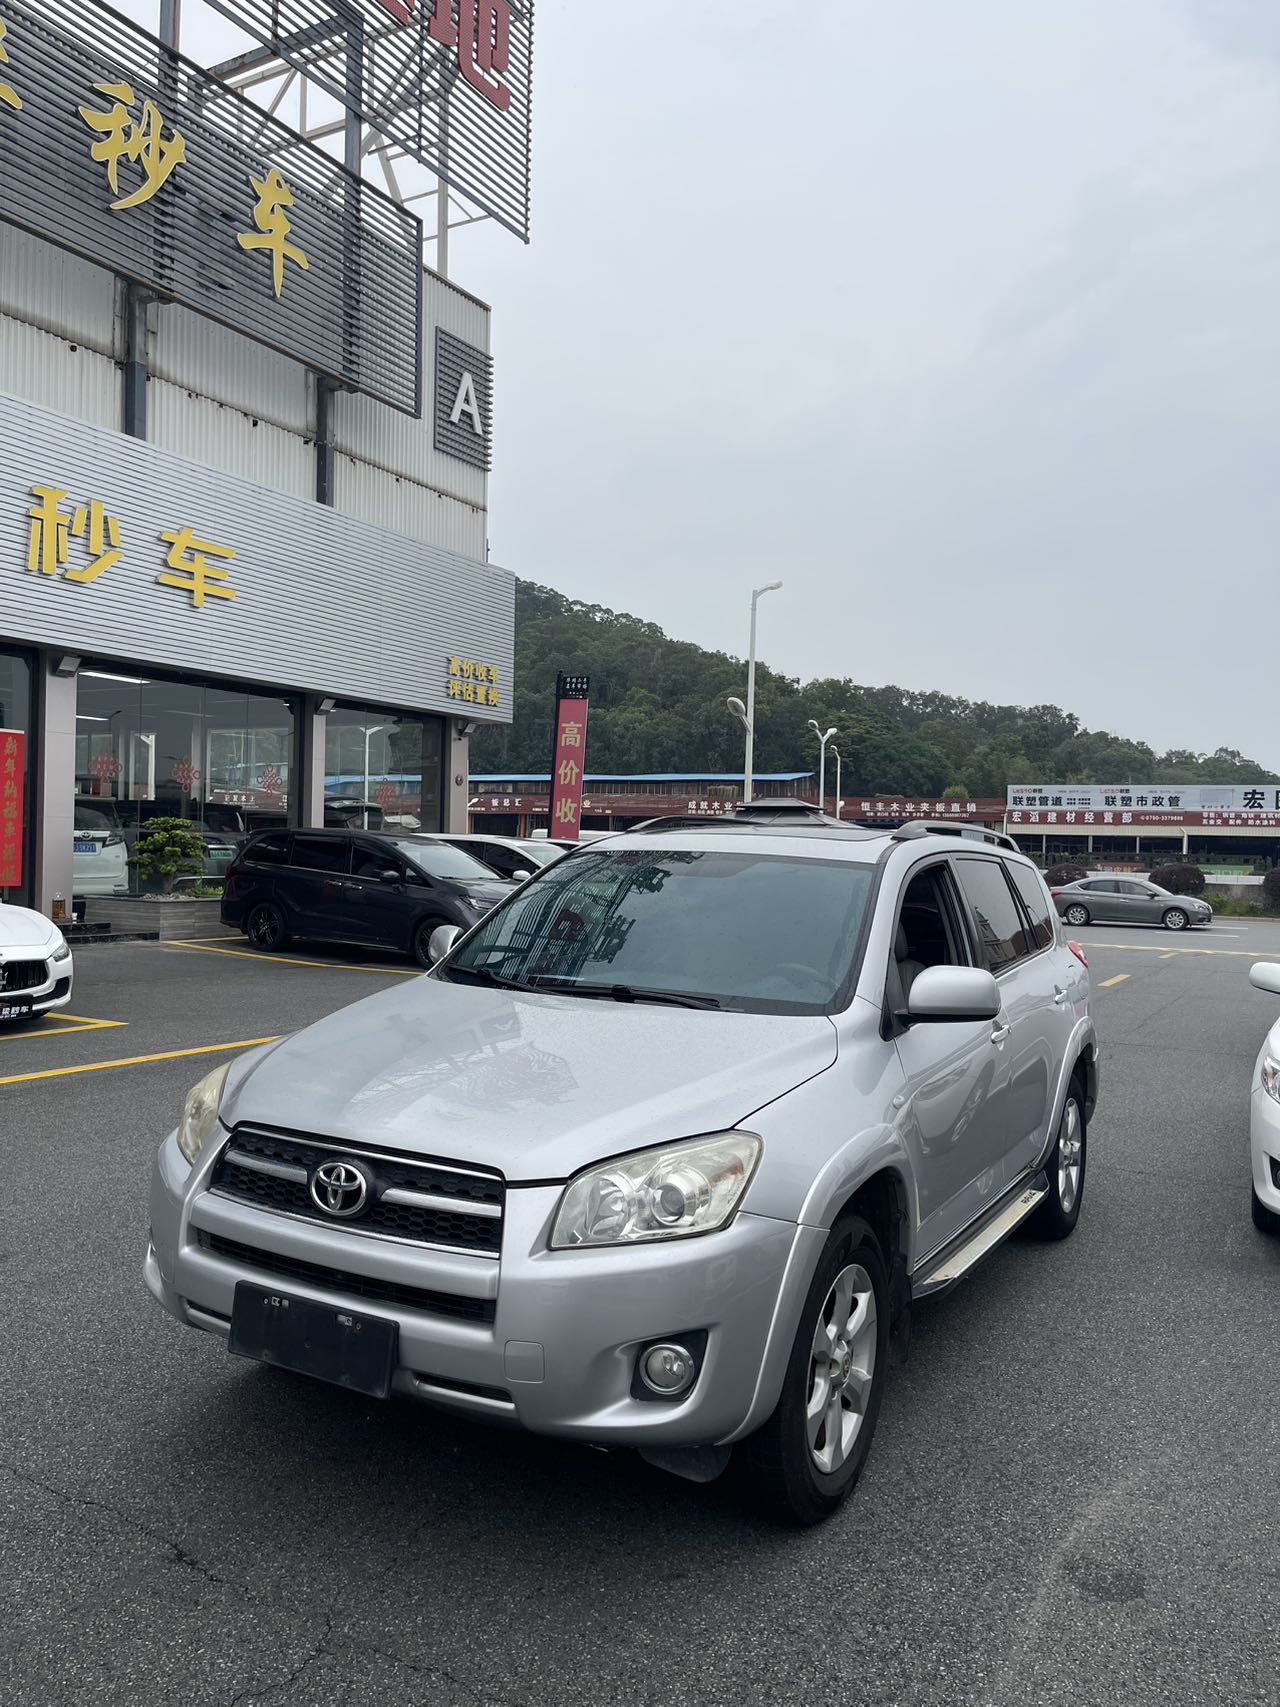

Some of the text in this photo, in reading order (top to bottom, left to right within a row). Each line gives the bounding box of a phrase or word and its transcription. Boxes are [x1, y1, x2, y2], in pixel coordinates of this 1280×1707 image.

[376, 0, 510, 111] 地
[0, 14, 309, 298] 秒车
[450, 372, 482, 435] A
[27, 485, 236, 608] 秒车
[449, 656, 497, 684] 高价收车
[556, 722, 583, 823] 高价收
[861, 802, 976, 812] 恒丰木业夹板直销
[1012, 796, 1063, 806] 联塑管道
[1104, 795, 1180, 807] 联塑市政管
[1243, 789, 1280, 811] 宏
